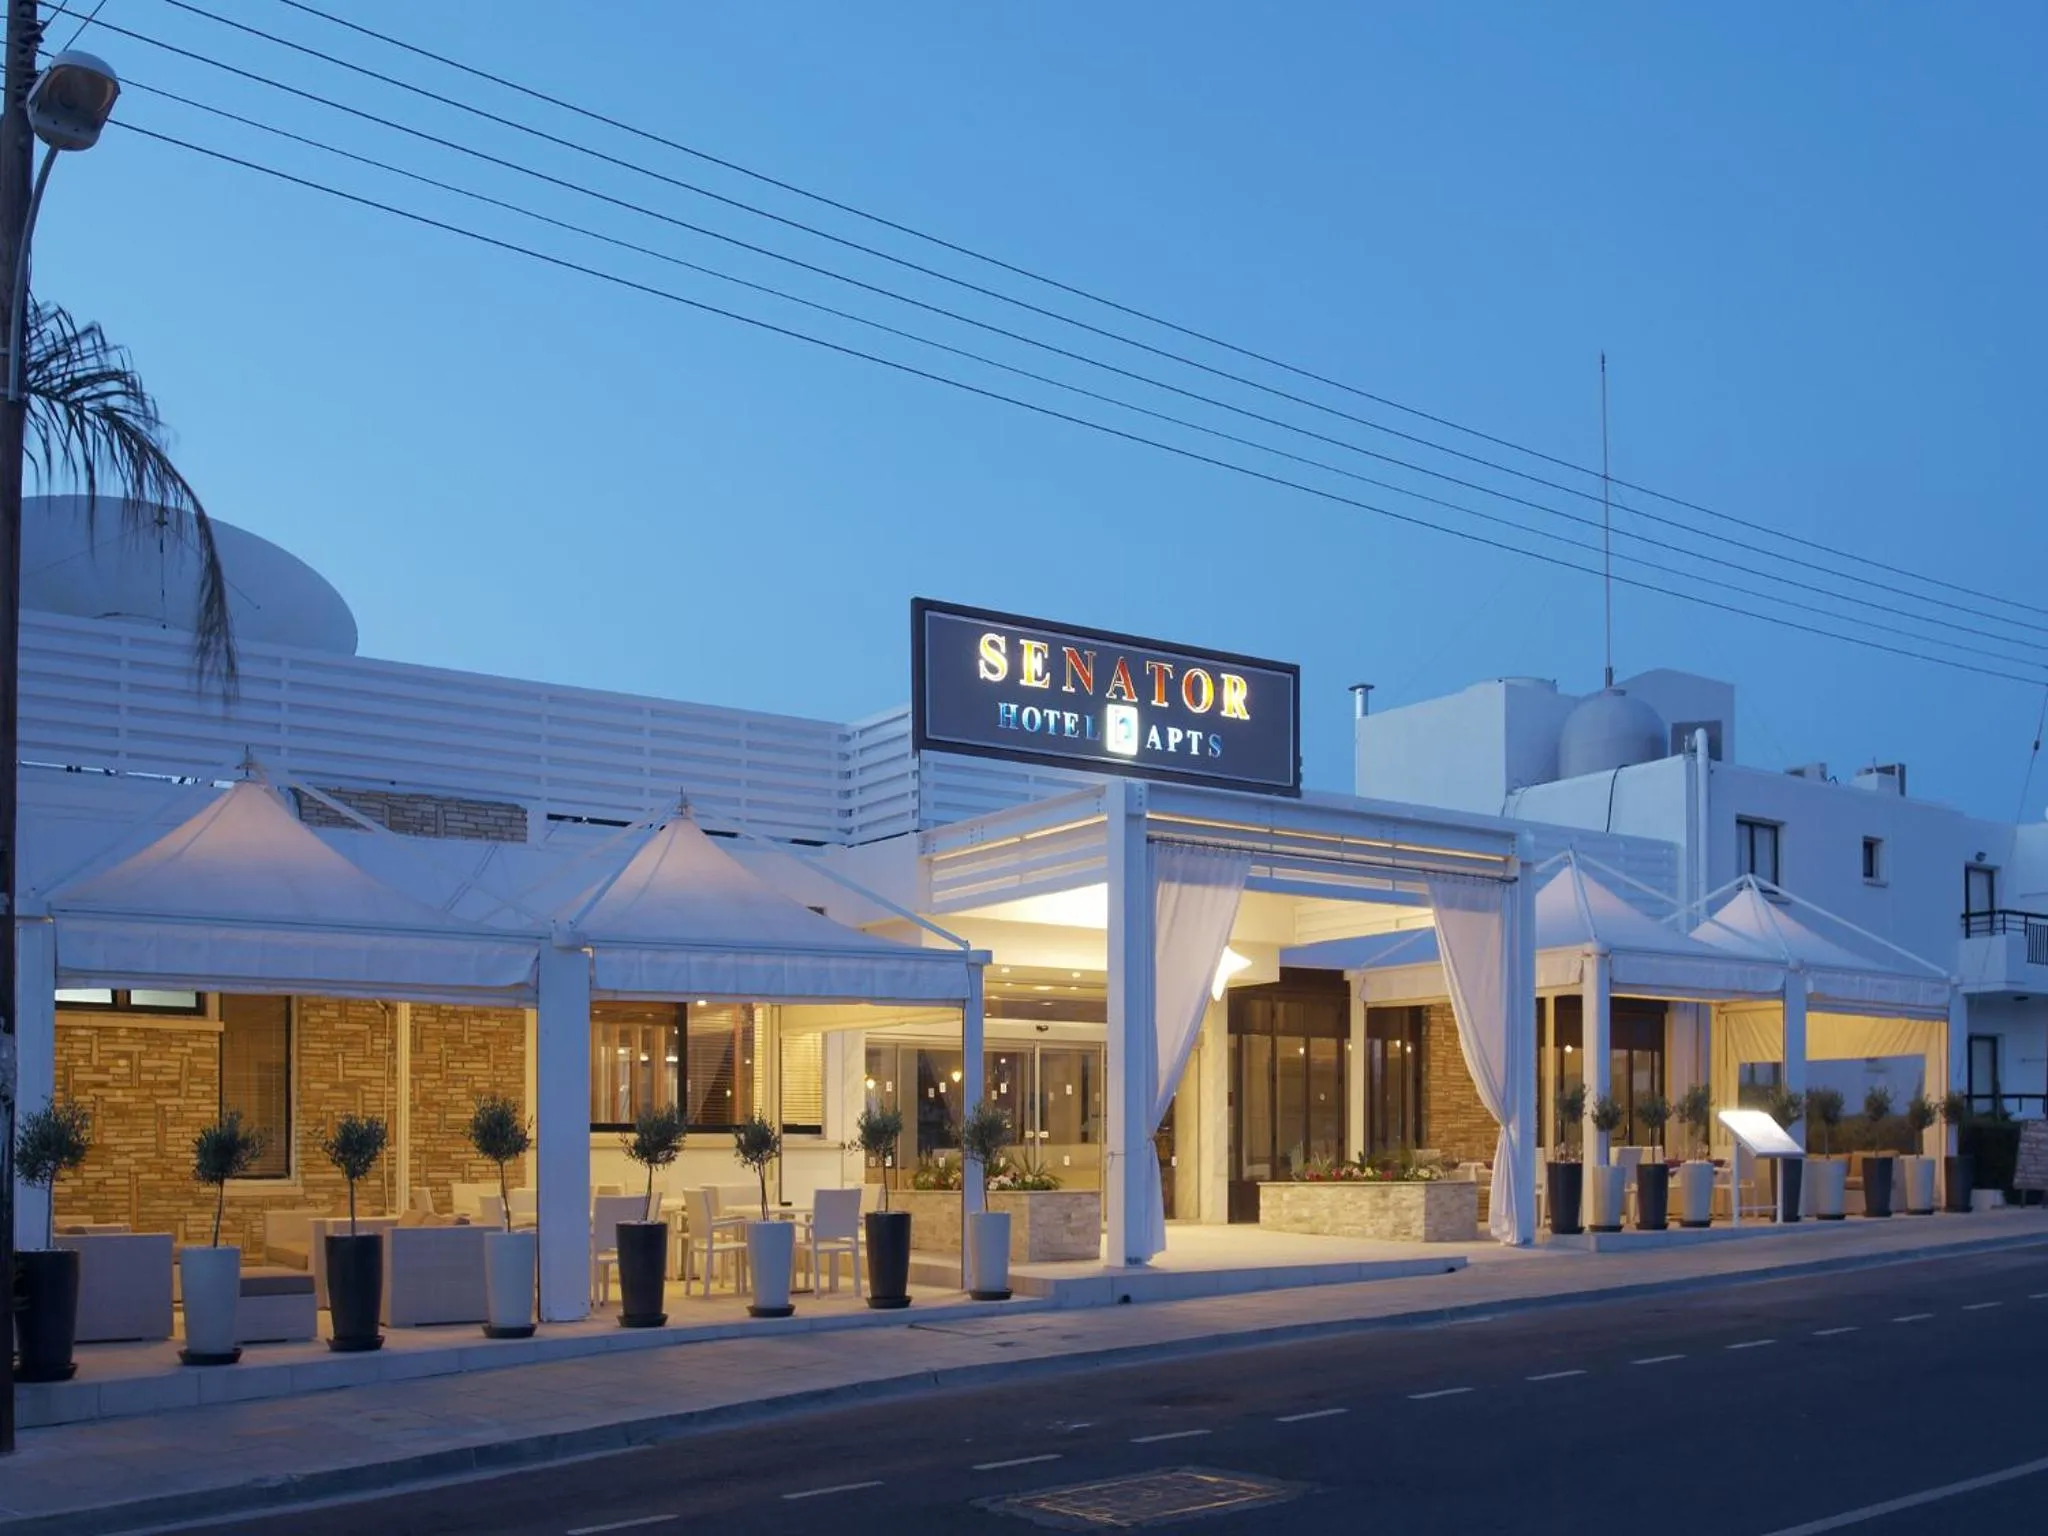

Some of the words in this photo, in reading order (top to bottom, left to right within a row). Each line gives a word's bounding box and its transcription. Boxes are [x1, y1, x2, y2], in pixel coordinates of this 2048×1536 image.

[978, 633, 1250, 720] SENATOR
[996, 702, 1101, 741] HOTEL
[1146, 724, 1222, 758] APTS
